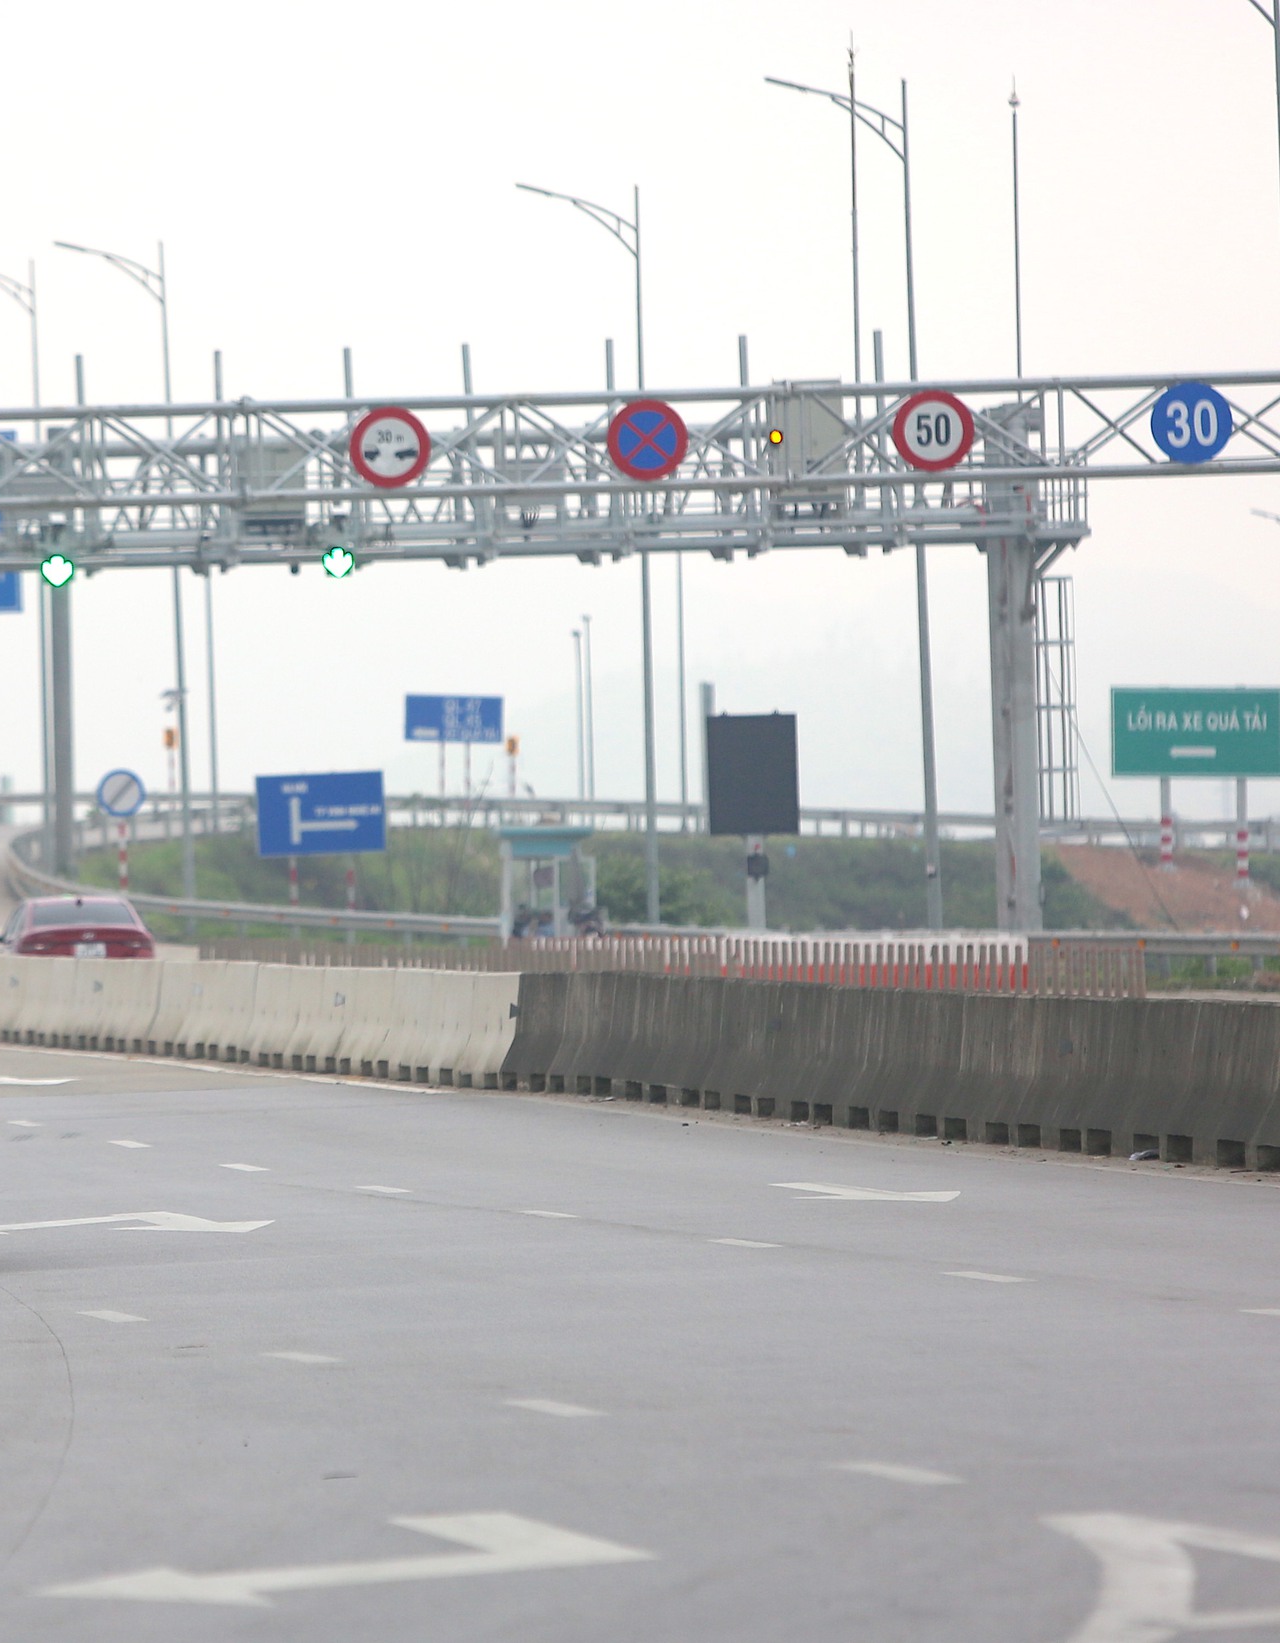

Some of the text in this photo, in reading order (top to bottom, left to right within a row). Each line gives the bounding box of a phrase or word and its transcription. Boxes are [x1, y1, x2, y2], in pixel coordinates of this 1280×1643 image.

[377, 429, 393, 444] 30
[916, 413, 951, 447] 50
[1166, 399, 1218, 449] 30
[1128, 703, 1268, 732] LỐI RA XE QUÁ TẢI
